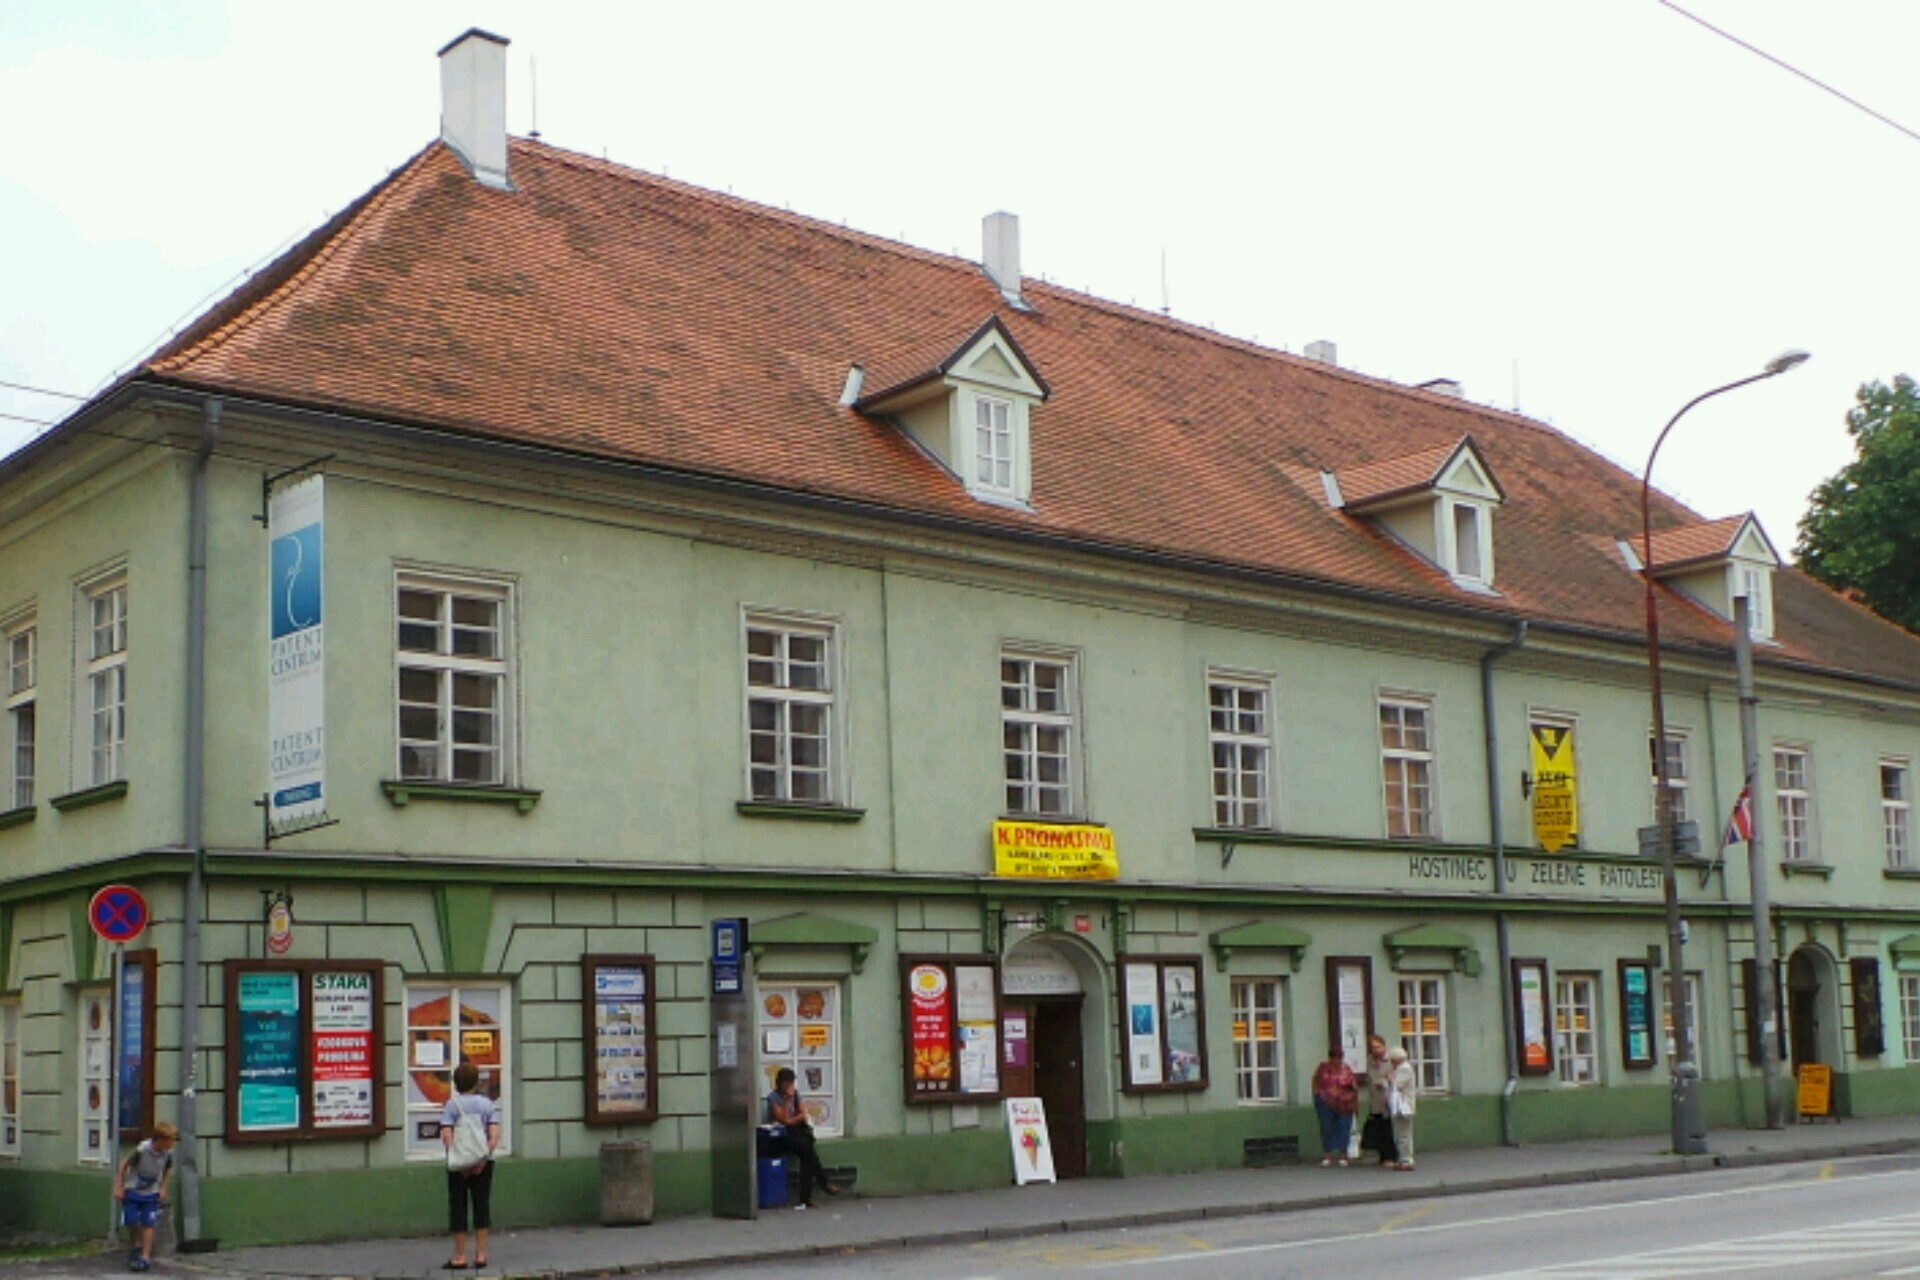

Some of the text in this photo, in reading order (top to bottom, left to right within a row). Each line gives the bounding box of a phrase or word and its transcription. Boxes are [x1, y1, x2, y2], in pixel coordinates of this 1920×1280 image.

[271, 629, 321, 659] PATENT
[271, 648, 321, 676] CENTRUM
[998, 827, 1010, 846] K
[1409, 856, 1487, 881] HOSTINEC
[1505, 860, 1517, 884] U
[1600, 865, 1664, 889] RATOLEST
